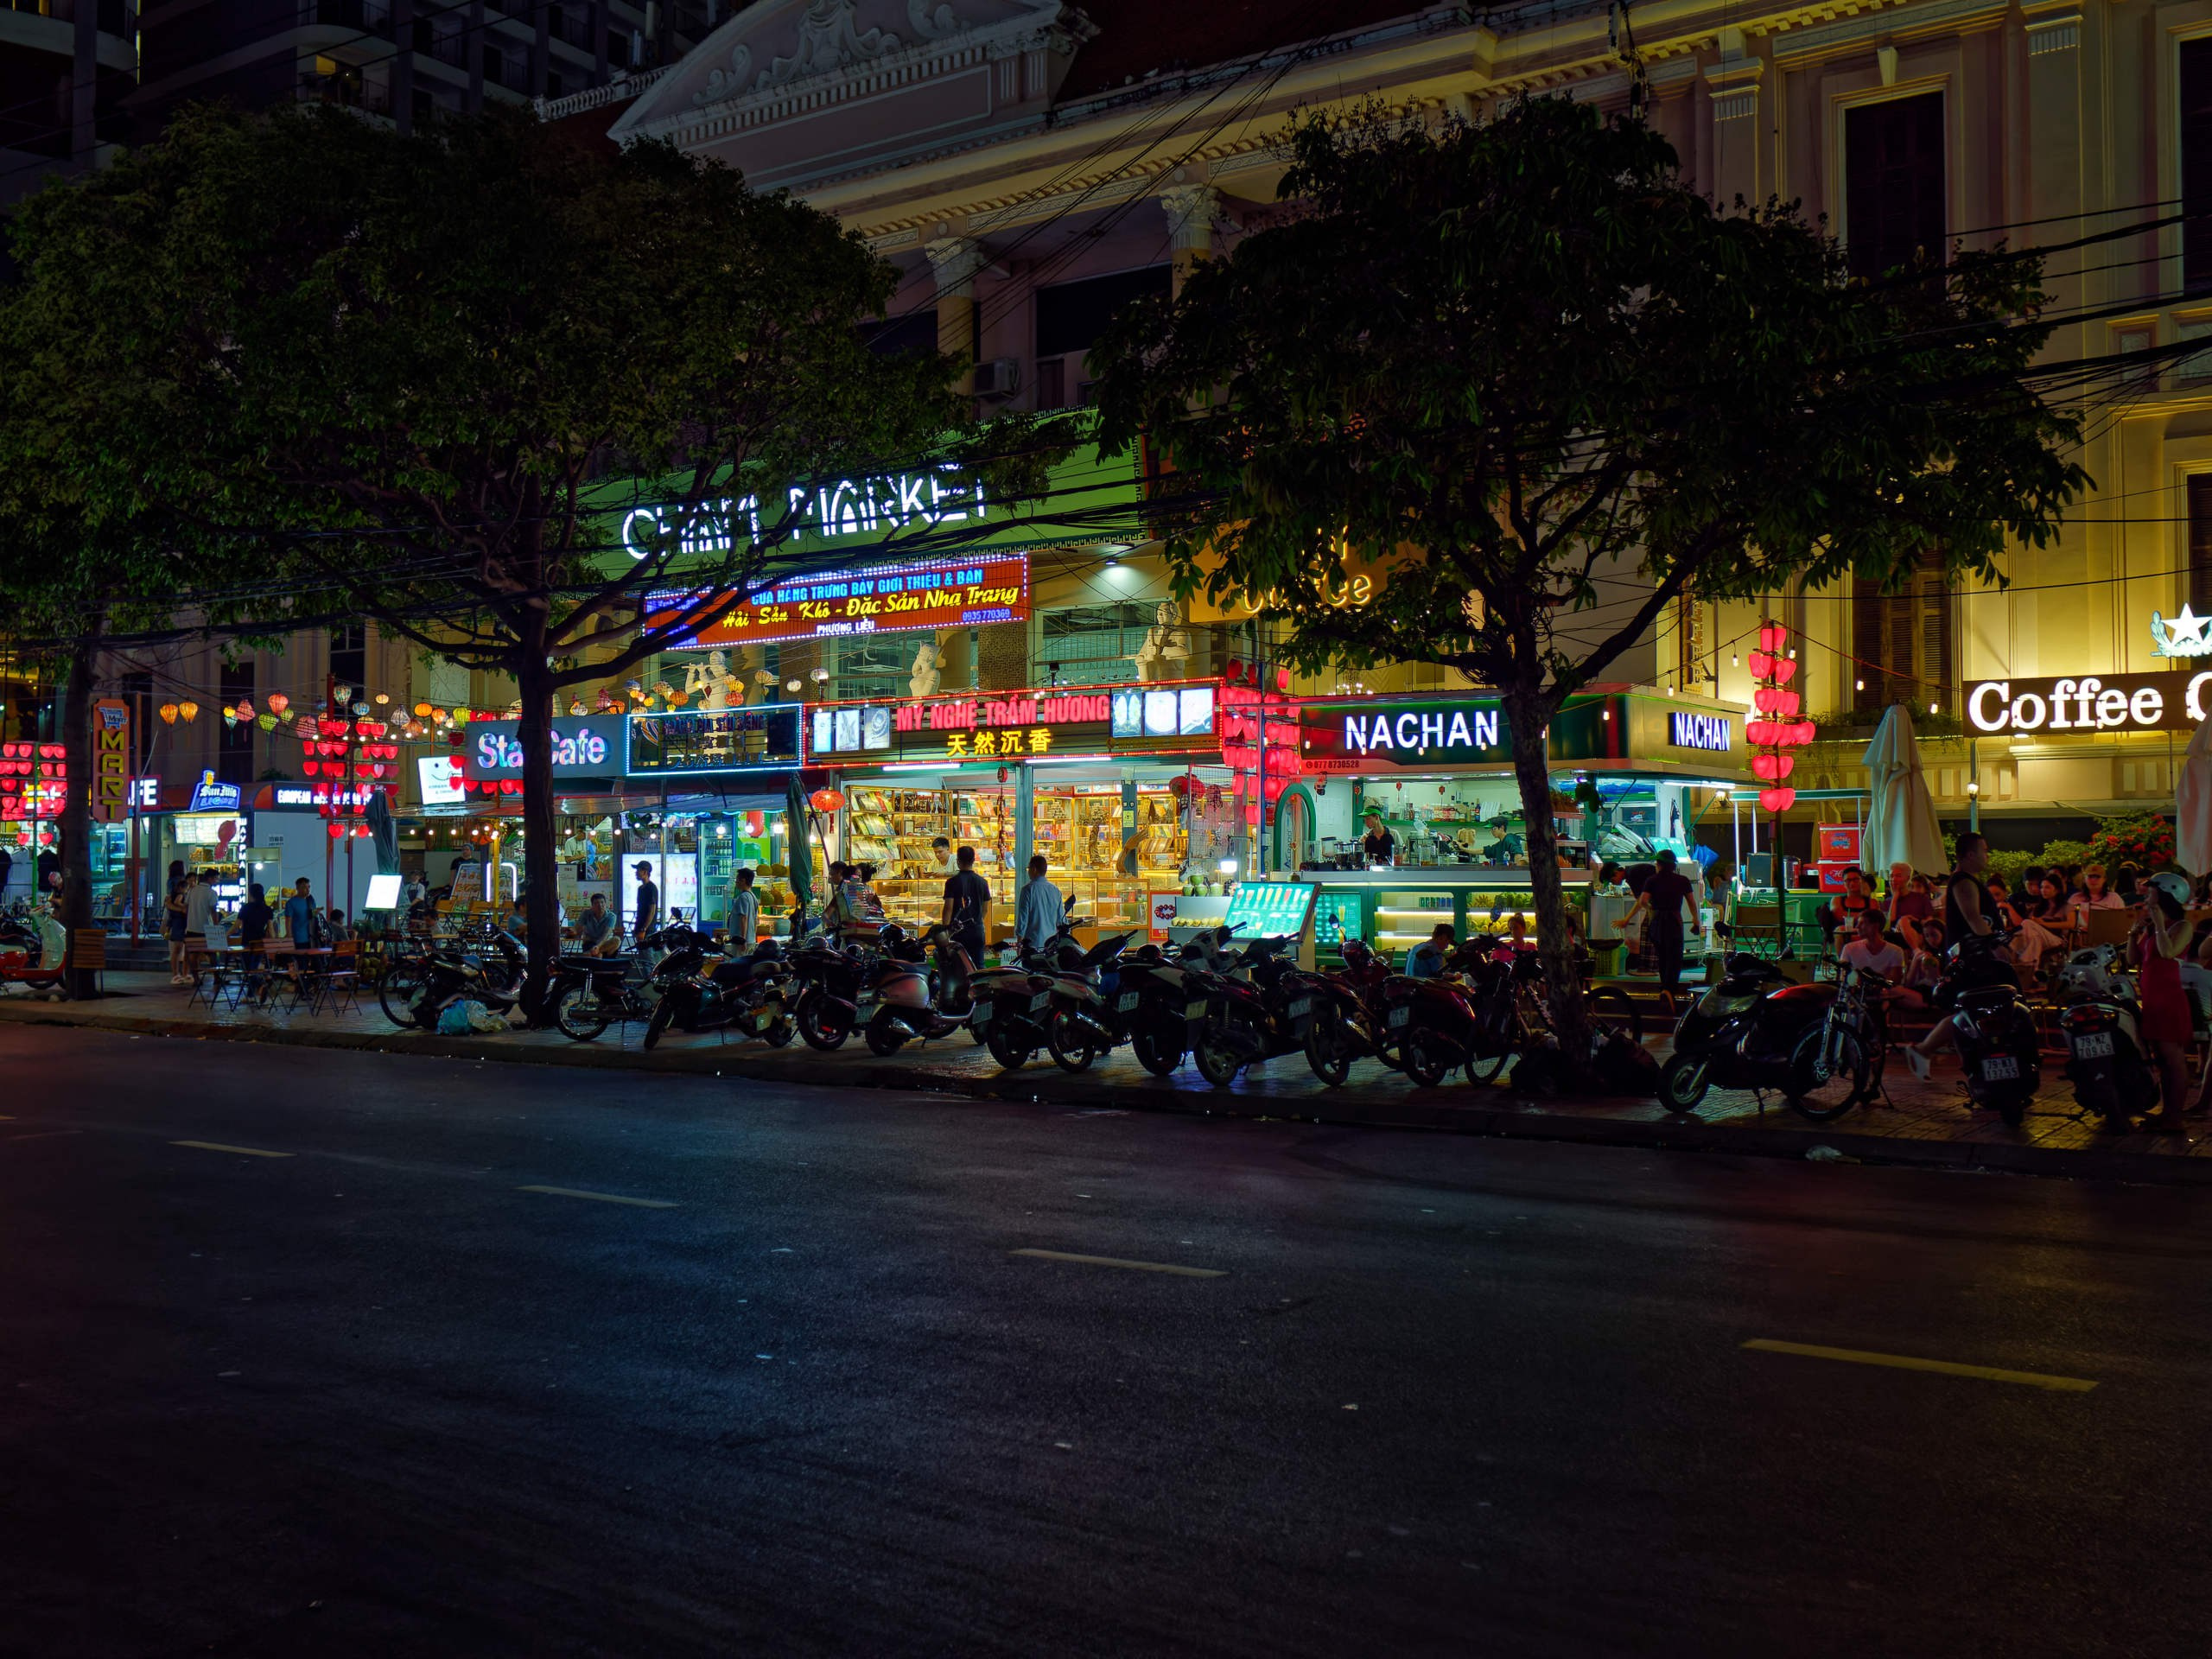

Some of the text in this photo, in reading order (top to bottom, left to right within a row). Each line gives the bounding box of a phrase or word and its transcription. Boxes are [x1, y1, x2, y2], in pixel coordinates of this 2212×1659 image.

[944, 573, 954, 588] &
[798, 601, 831, 620] Khô
[846, 596, 881, 620] Đặc
[884, 593, 920, 613] Sản
[924, 589, 962, 608] Nha
[967, 586, 1019, 606] Trang
[930, 698, 978, 733] NGHỆ
[985, 694, 1038, 728] TRẦM
[1044, 696, 1110, 723] HƯƠNG
[1968, 677, 2164, 732] Coffee
[946, 728, 1053, 757] 天然沉香
[1344, 710, 1498, 751] NACHAN
[1675, 711, 1731, 752] NACHAN
[477, 733, 524, 769] Sta
[101, 730, 125, 820] MART
